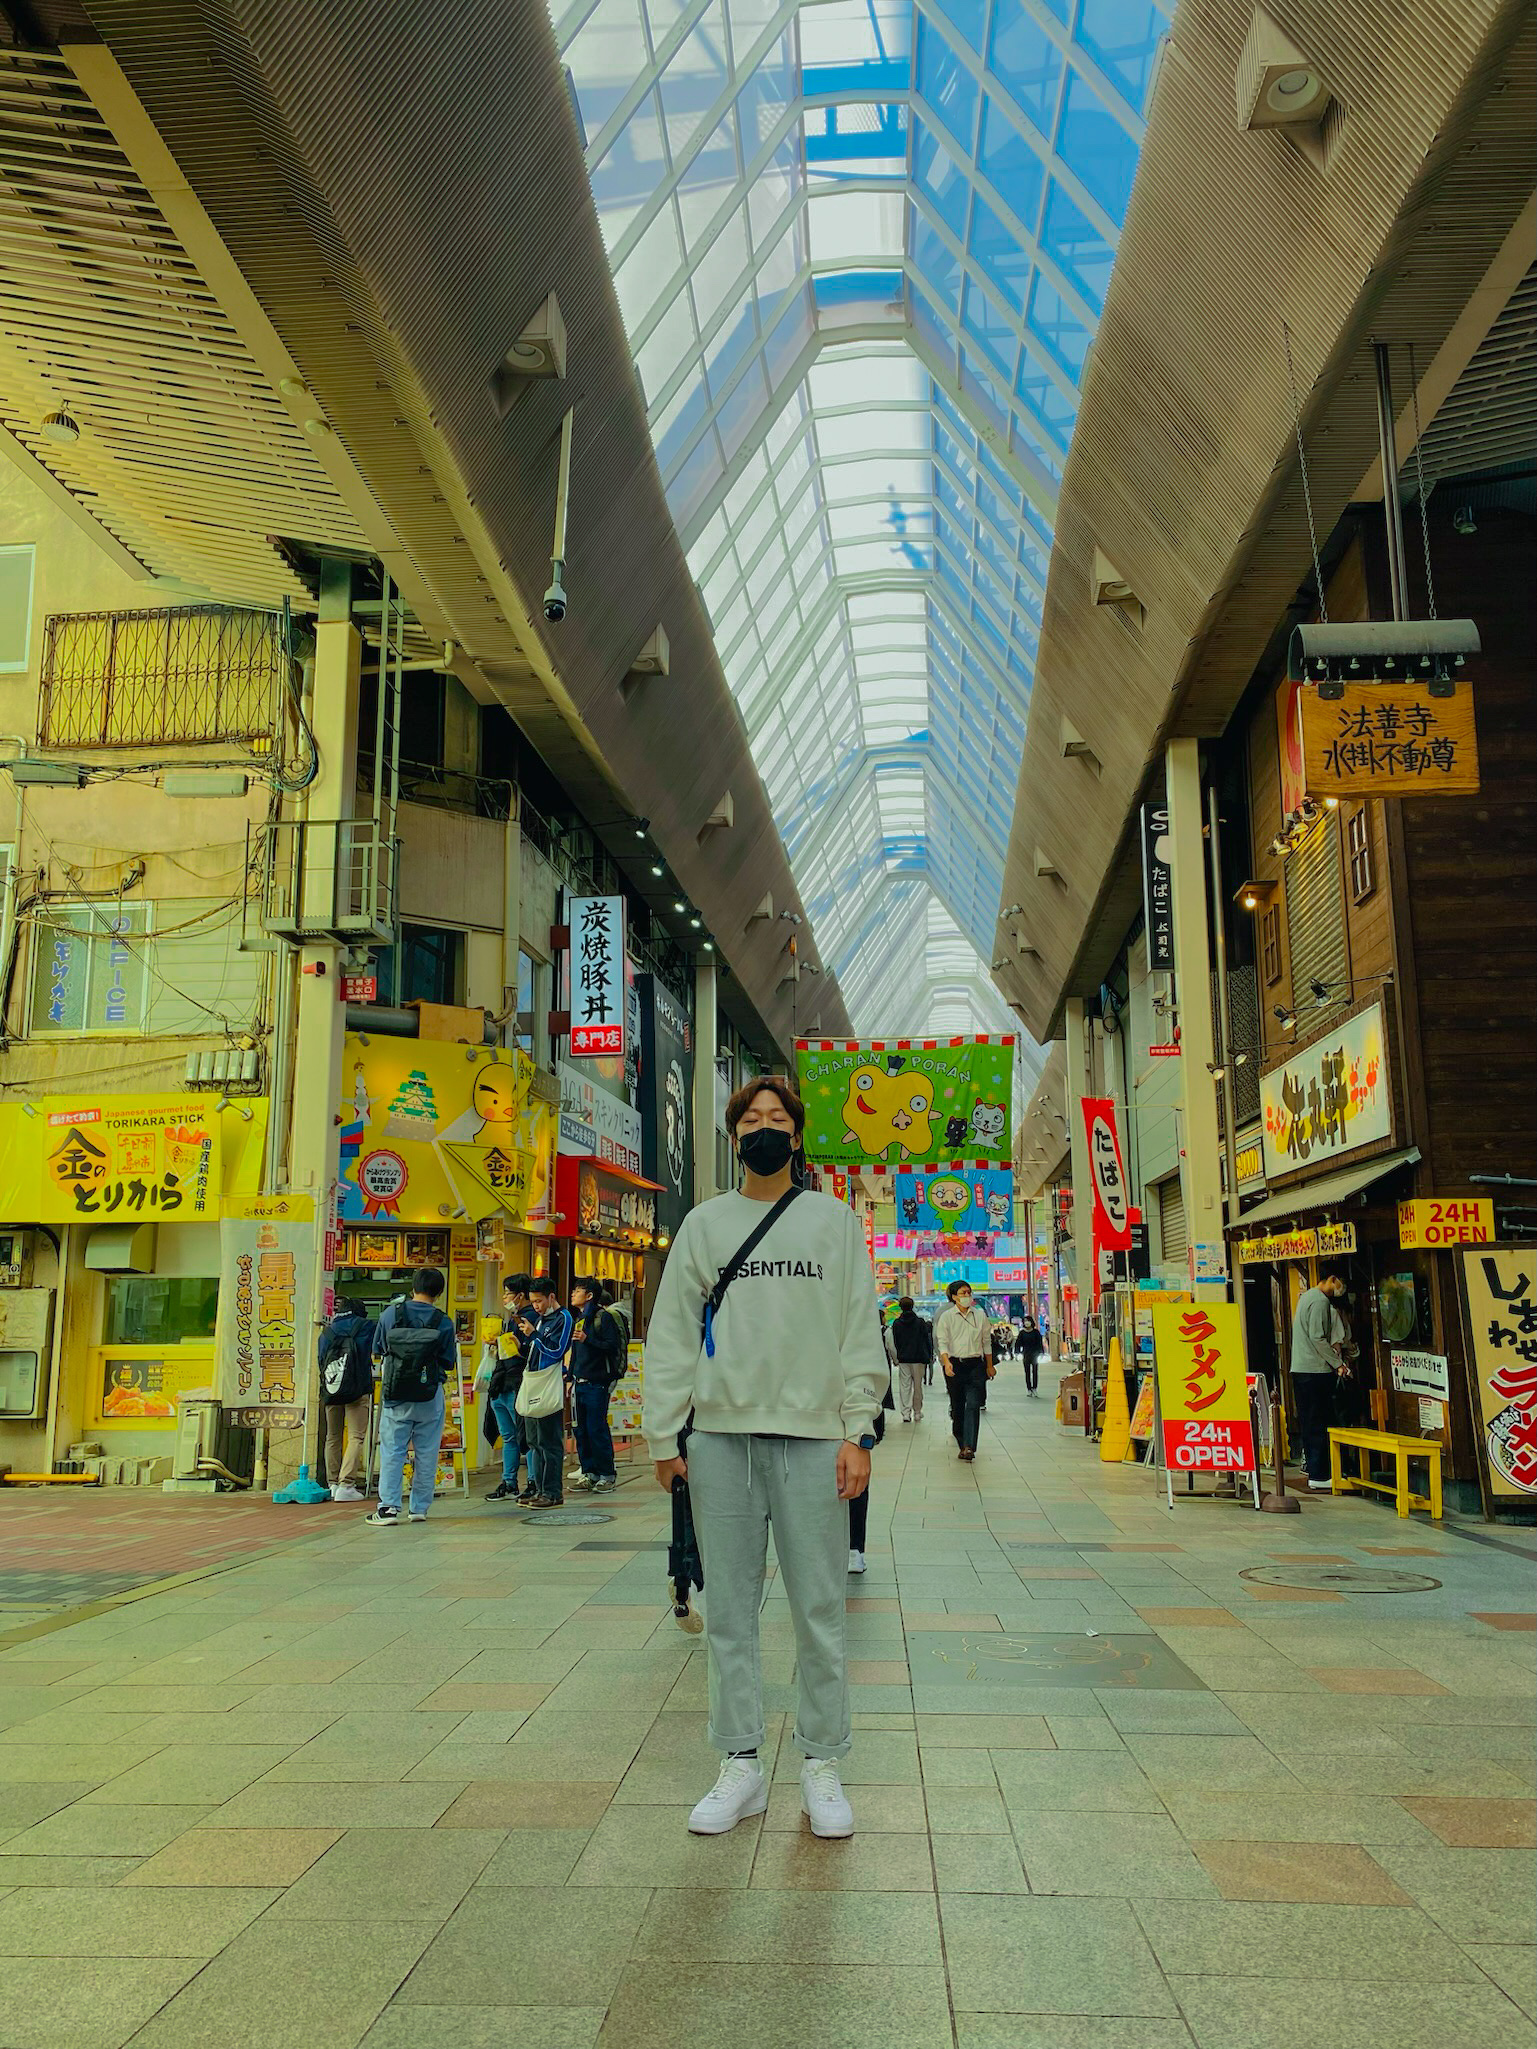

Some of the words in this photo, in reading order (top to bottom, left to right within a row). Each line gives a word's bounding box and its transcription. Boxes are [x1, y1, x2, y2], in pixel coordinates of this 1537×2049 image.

[1337, 702, 1438, 738] 法善寺
[1322, 737, 1458, 779] 水掛不動尊
[1152, 866, 1168, 914] たばこ
[106, 916, 131, 1022] OFFICE
[574, 1031, 621, 1048] 専門店
[806, 1052, 882, 1082] CHARAN
[911, 1056, 971, 1084] PORAN
[105, 1109, 146, 1118] Japanese
[148, 1106, 183, 1116] gourmet
[186, 1104, 205, 1112] food
[106, 1117, 165, 1129] TORIKARA
[170, 1114, 204, 1124] STICK
[594, 1099, 641, 1145] スキンクリニック
[47, 1128, 106, 1180] 金の
[1094, 1127, 1125, 1220] たばこ
[74, 1172, 183, 1213] とりから
[1400, 1205, 1415, 1225] 24H
[1429, 1203, 1480, 1223] 24H
[1401, 1230, 1417, 1243] OPEN
[1425, 1226, 1487, 1243] OPEN
[1178, 1310, 1226, 1412] ラーメン
[1184, 1421, 1231, 1443] 24H
[1175, 1445, 1245, 1467] OPEN
